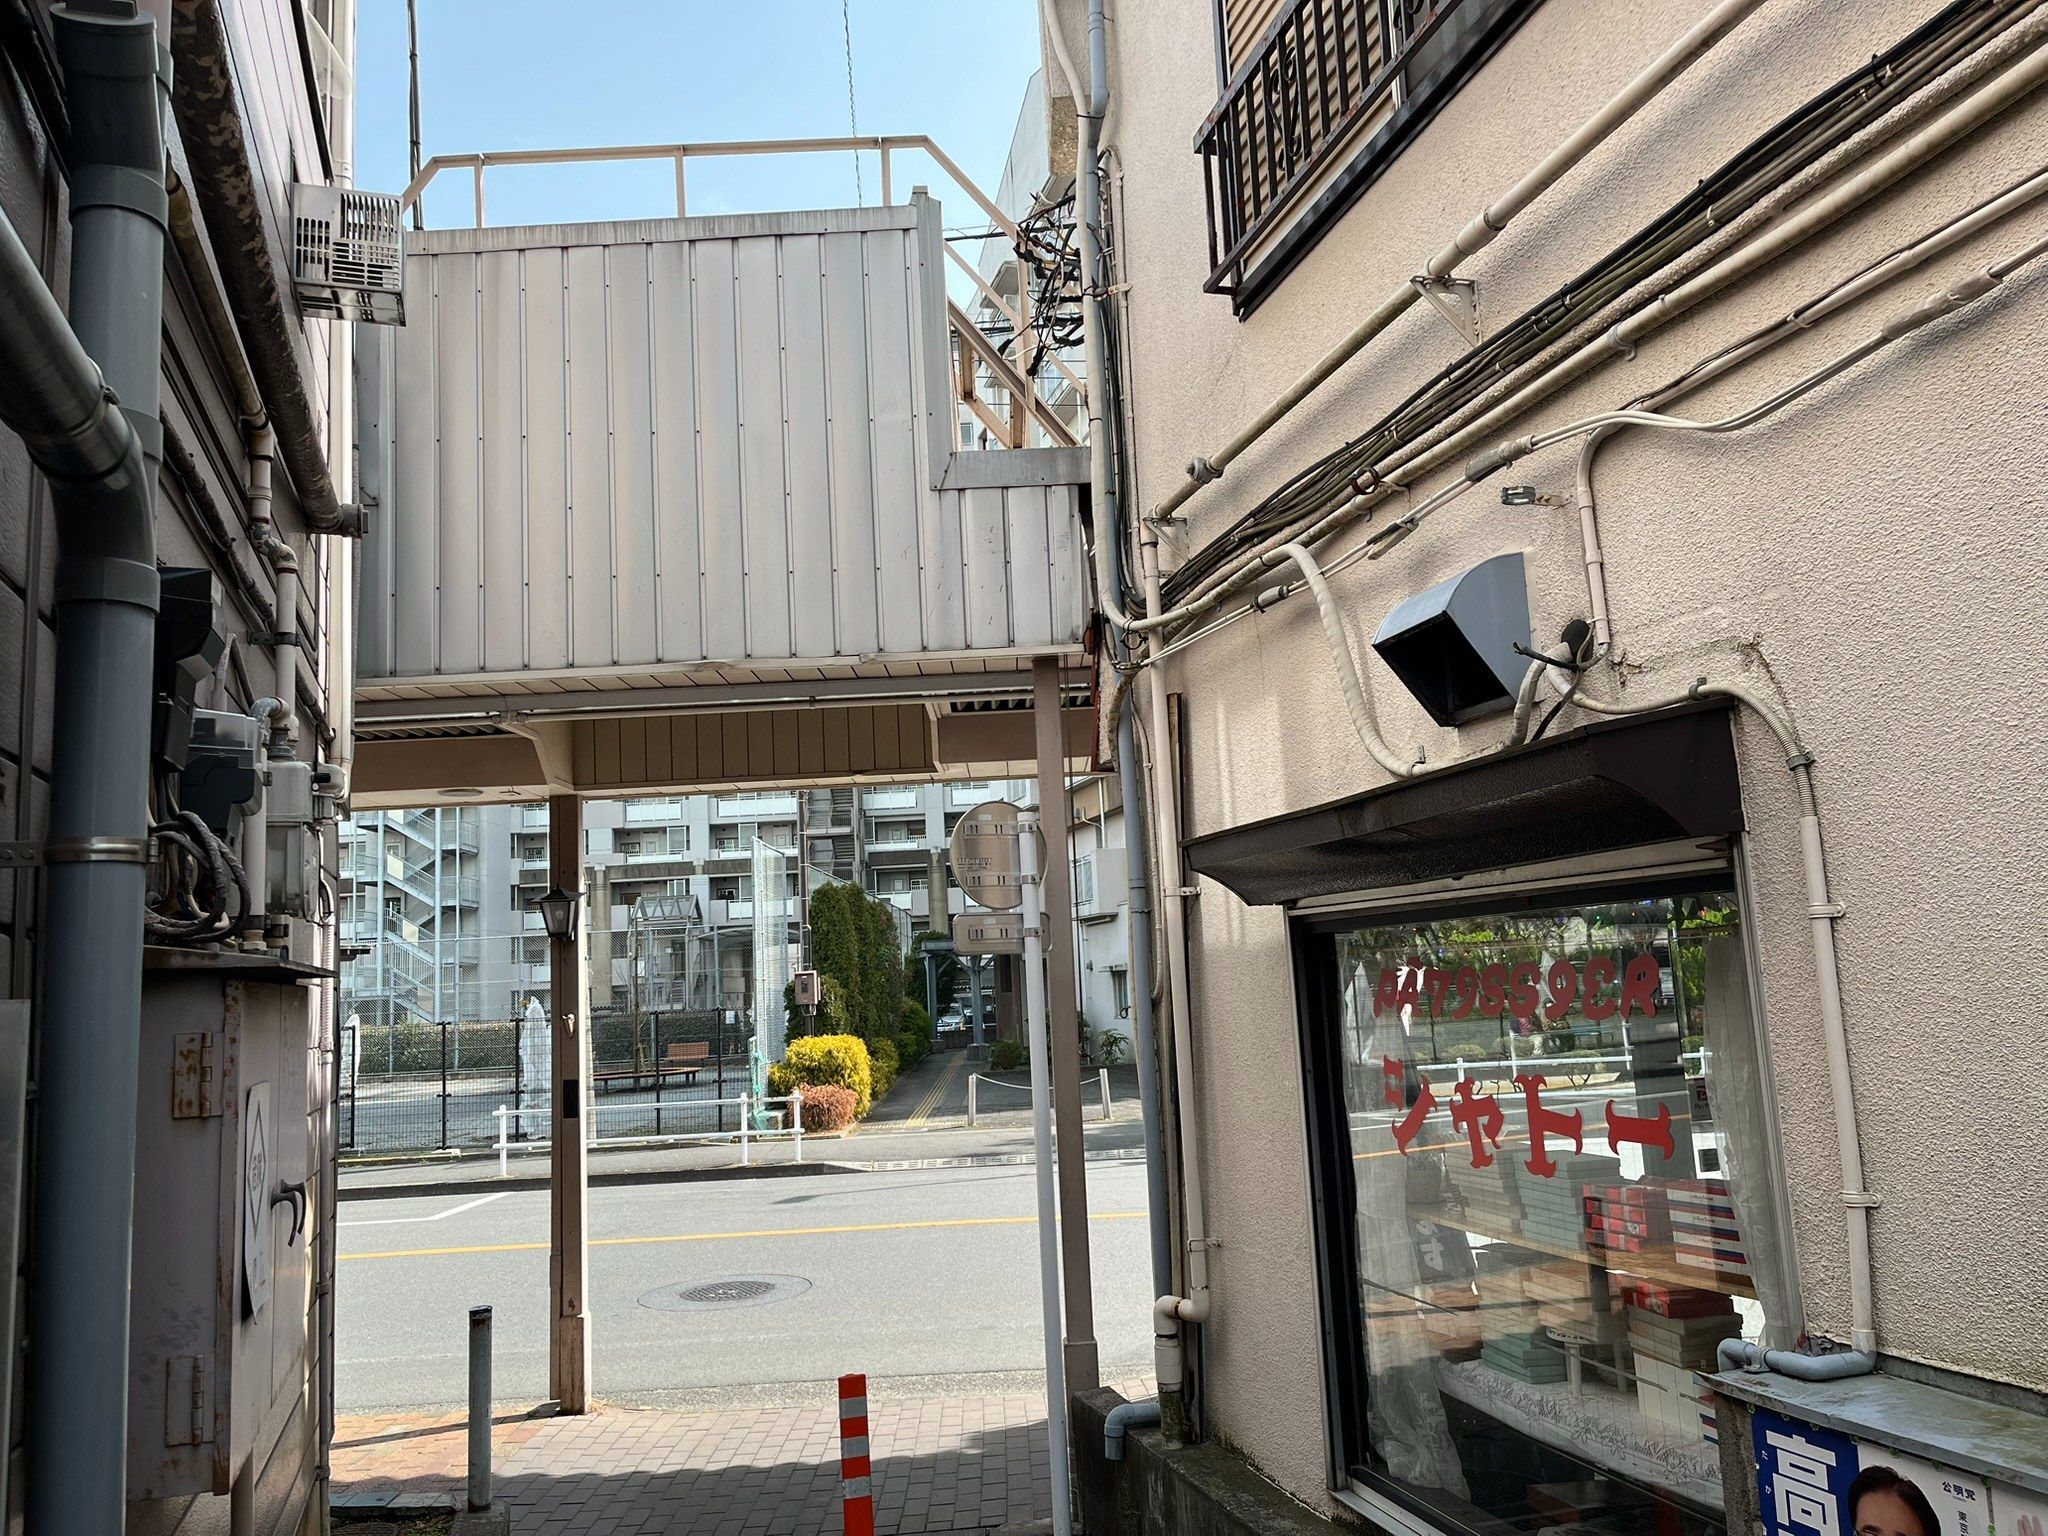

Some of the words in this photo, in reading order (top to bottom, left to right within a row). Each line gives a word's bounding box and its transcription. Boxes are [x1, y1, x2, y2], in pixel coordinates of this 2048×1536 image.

[1383, 1054, 1675, 1179] シャトー
[1766, 1430, 1841, 1536] 高
[1941, 1480, 1977, 1502] 公明党
[1957, 1510, 1971, 1536] 東京
